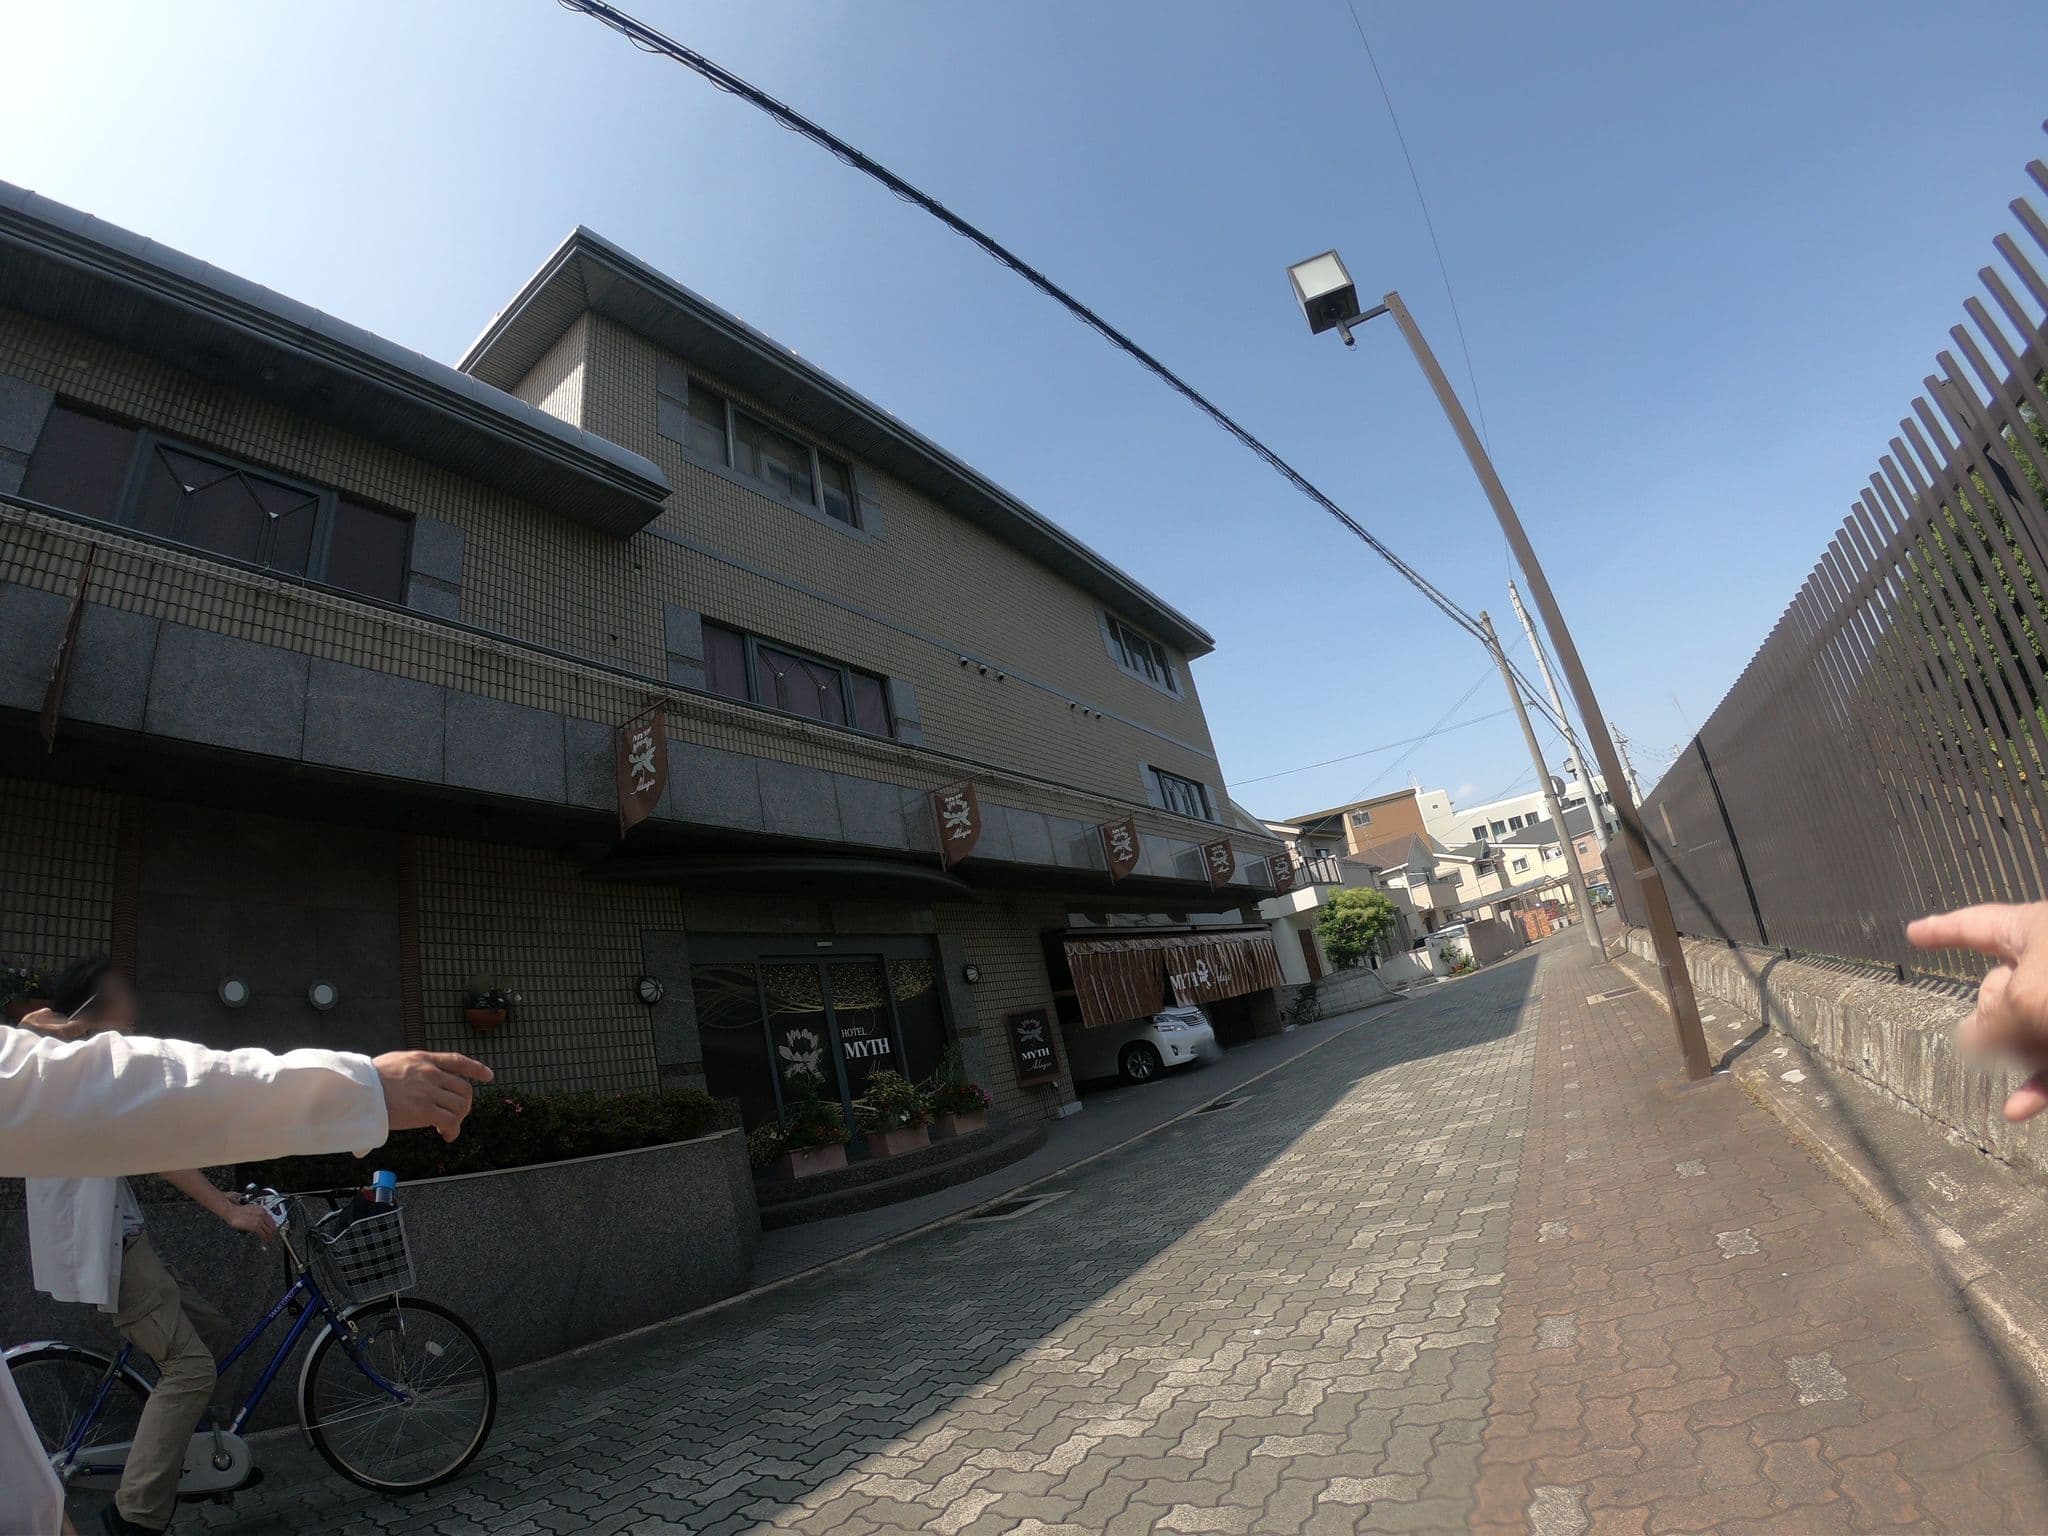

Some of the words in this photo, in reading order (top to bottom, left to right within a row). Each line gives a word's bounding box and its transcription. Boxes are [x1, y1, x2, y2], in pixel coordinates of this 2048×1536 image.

[841, 1026, 867, 1039] HOTEL
[844, 1037, 891, 1060] MYTH
[1021, 1047, 1051, 1061] MYTH
